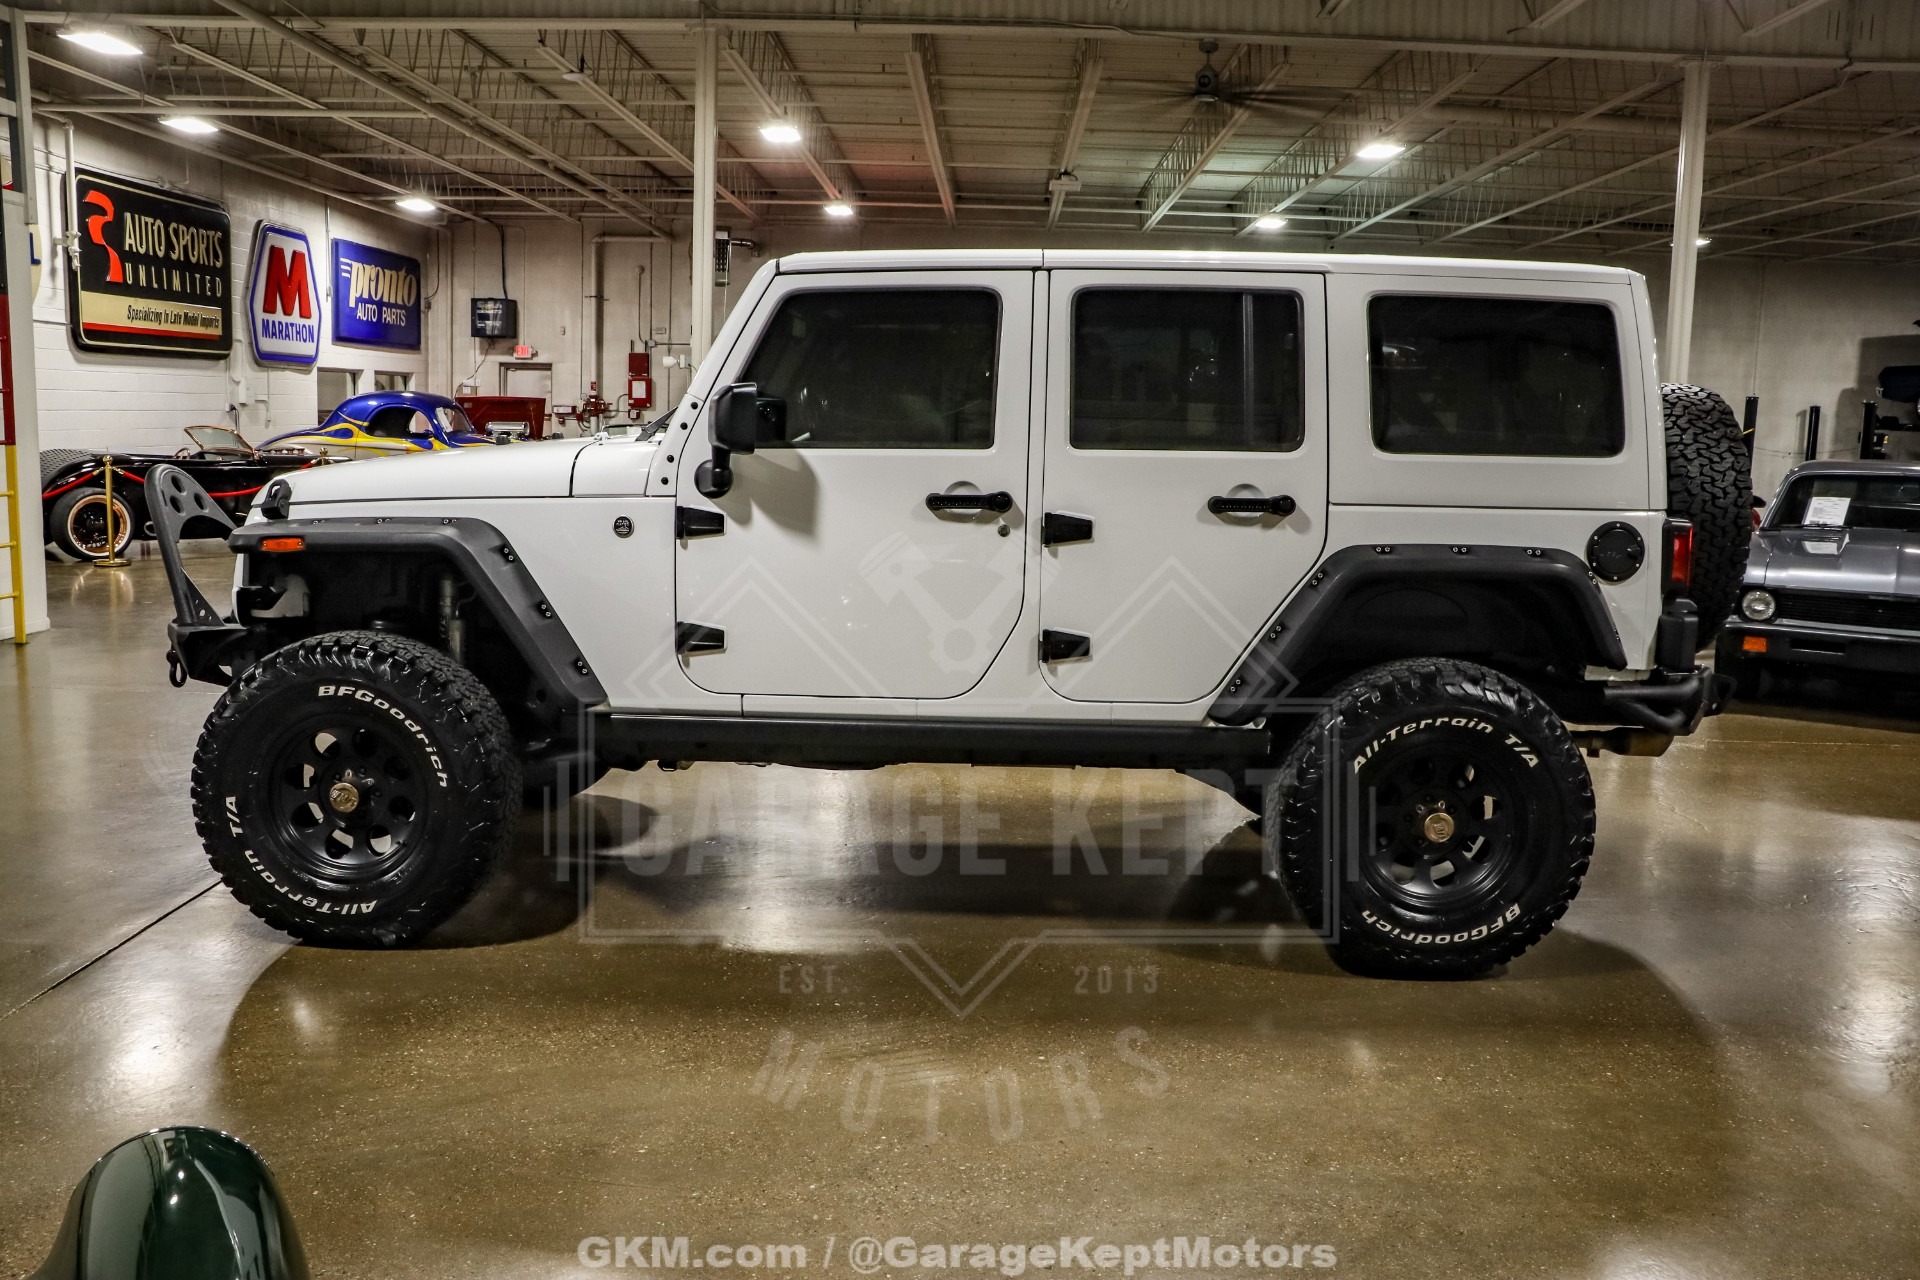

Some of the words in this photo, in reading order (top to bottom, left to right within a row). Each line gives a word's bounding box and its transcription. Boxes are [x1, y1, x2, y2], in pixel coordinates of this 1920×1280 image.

[124, 211, 165, 258] AUTO
[169, 222, 223, 269] SPORTS
[124, 262, 222, 298] UNLIMITED
[348, 260, 417, 308] pronto
[127, 304, 163, 326] Specializing
[169, 310, 182, 325] Late
[182, 310, 200, 327] Model
[200, 311, 220, 330] Imports
[261, 318, 315, 344] MARATHON
[356, 302, 378, 323] AUTO
[381, 306, 406, 327] PARTS
[317, 684, 448, 788] BFGoodrich
[1354, 716, 1494, 775] All-Terrain
[1503, 733, 1539, 769] T/A
[225, 795, 245, 838] T/A
[244, 849, 378, 915] All-Terrain
[1361, 902, 1521, 946] BFGoodrich
